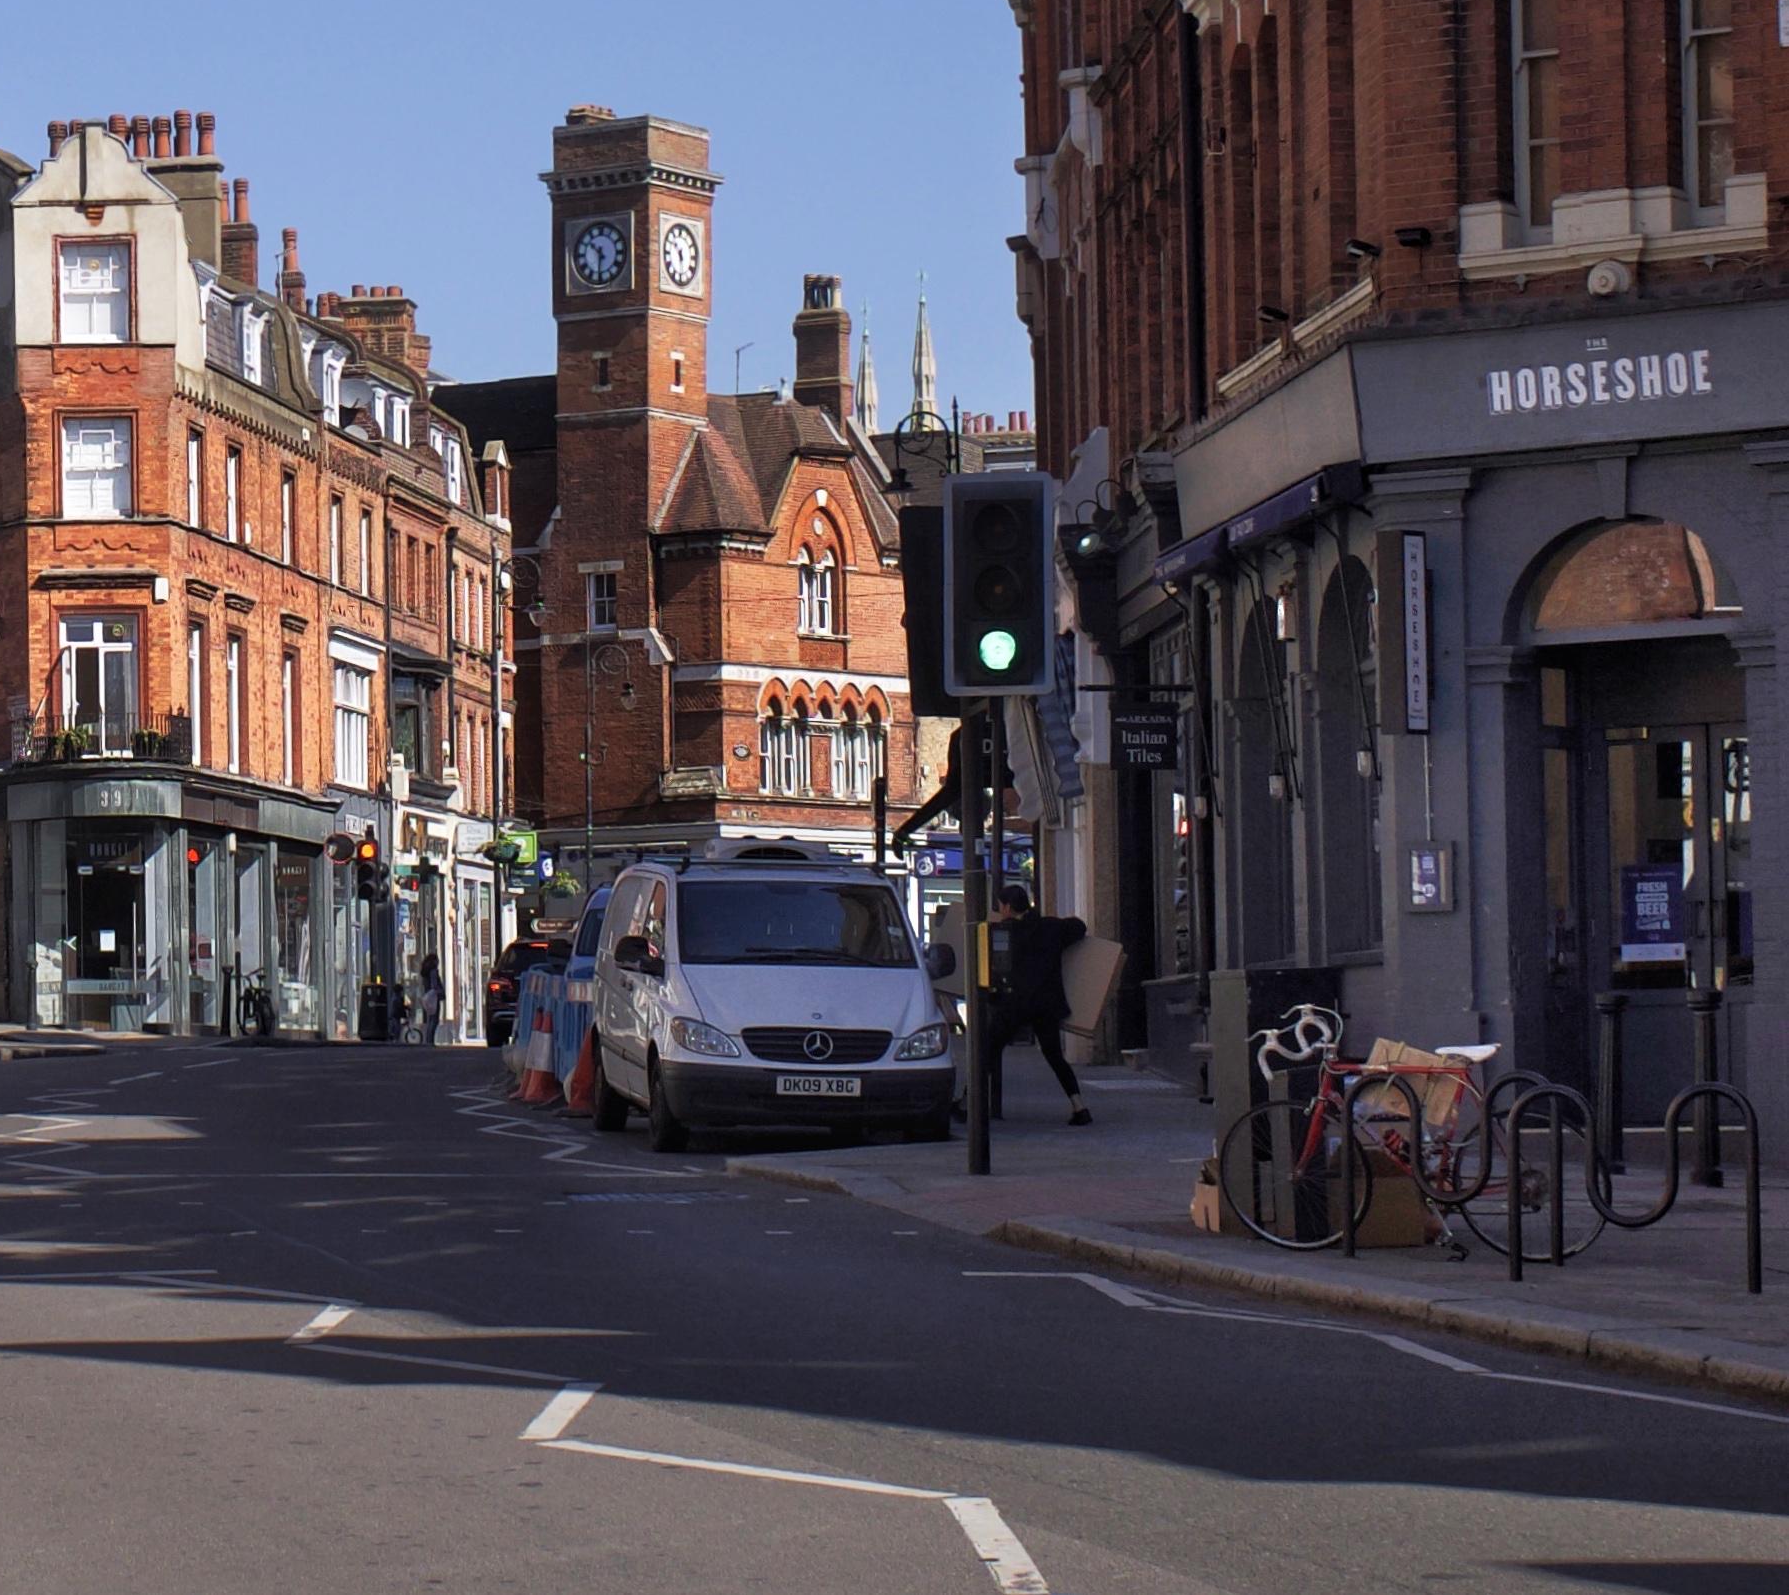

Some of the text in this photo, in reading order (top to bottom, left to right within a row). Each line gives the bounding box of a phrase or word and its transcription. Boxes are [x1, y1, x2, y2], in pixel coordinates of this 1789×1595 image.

[1586, 338, 1608, 347] THE
[1488, 350, 1711, 415] HORSESHOE
[1122, 730, 1167, 744] Italian
[1126, 749, 1162, 763] Tiles
[1637, 882, 1668, 892] FRESH
[1637, 903, 1668, 916] BEER
[783, 1079, 821, 1092] DK09
